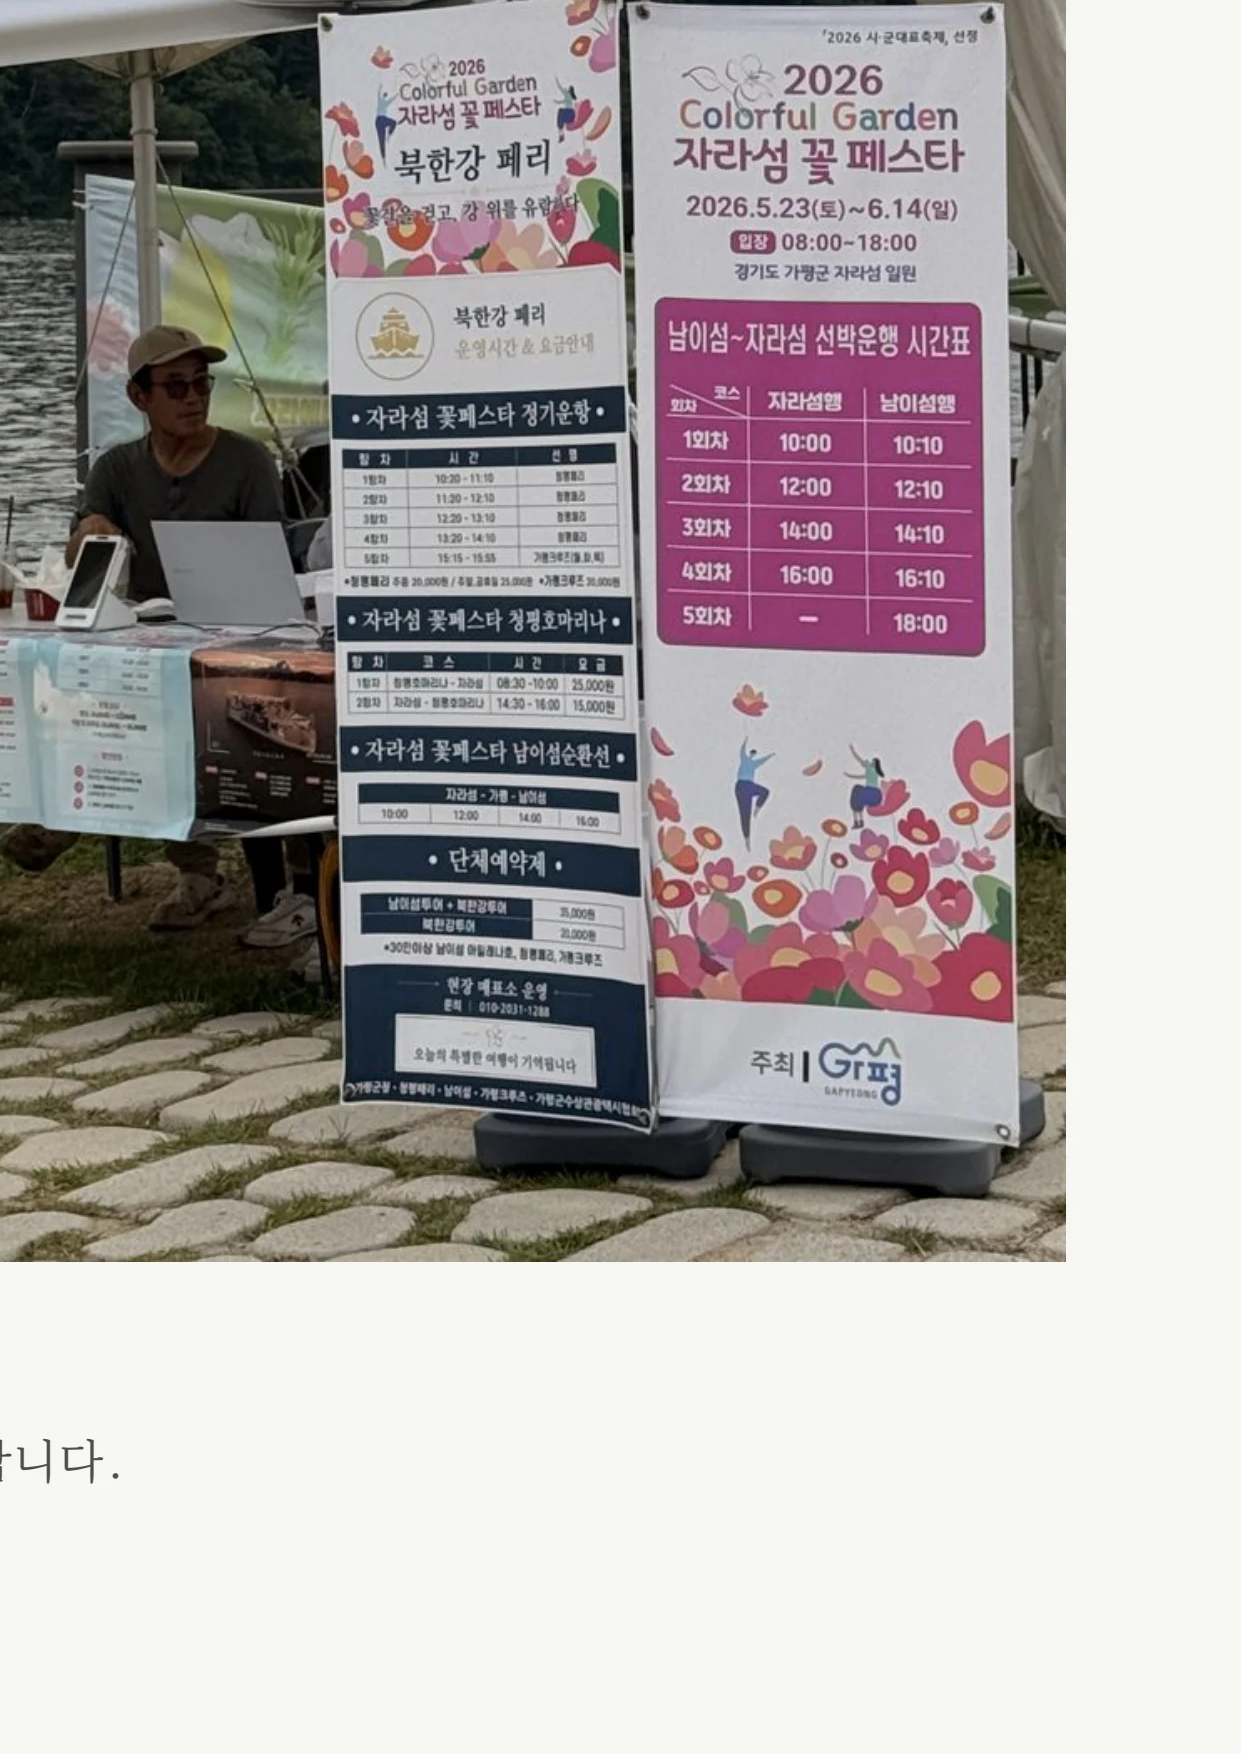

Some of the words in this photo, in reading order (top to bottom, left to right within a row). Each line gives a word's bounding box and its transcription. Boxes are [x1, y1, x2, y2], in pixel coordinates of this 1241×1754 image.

[953, 29, 978, 44] 선정
[449, 59, 486, 77] 2026
[783, 63, 884, 96] 2026
[399, 79, 468, 101] Colorful
[476, 75, 537, 97] Garden
[398, 103, 455, 131] 자라섬
[461, 101, 480, 129] 꽃
[484, 95, 542, 121] 페스타
[679, 99, 817, 131] Colorful
[833, 101, 959, 132] Garden
[394, 144, 486, 185] 북한강
[496, 138, 552, 179] 페리
[673, 137, 789, 184] 자라섬
[801, 138, 838, 186] 꽃
[846, 138, 966, 173] 페스타
[463, 201, 480, 222] 강
[486, 199, 517, 220] 위를
[686, 194, 958, 222] 2026.5.23(토)~6.14(일)
[738, 233, 768, 251] 입장
[781, 233, 917, 252] 08:00~18:00
[734, 264, 780, 282] 경기도
[784, 264, 830, 282] 가평군
[834, 264, 882, 282] 자라섬
[886, 264, 917, 282] 일원
[453, 304, 509, 328] 북한강
[513, 302, 546, 327] 페리
[454, 336, 519, 361] 운영시간
[539, 332, 594, 355] 요금안내
[668, 319, 806, 356] 남이섬~자라섬
[816, 324, 899, 358] 선박운행
[907, 325, 971, 358] 시간표
[670, 398, 697, 413] 회차
[768, 391, 842, 413] 자라섬행
[880, 393, 956, 414] 남이섬행
[713, 385, 741, 400] 코스
[365, 405, 429, 431] 자라섬
[435, 400, 516, 430] 꽃페스타
[521, 398, 591, 426] 정기운항
[683, 429, 729, 451] 1회차
[780, 433, 832, 453] 10:00
[893, 435, 943, 456] 10:10
[436, 473, 461, 484] 10:20
[470, 473, 494, 484] 11:10
[681, 473, 731, 494] 2회차
[780, 477, 832, 497] 12:00
[895, 479, 944, 499] 12:10
[436, 493, 461, 504] 11:20
[470, 493, 495, 504] 12:10
[437, 513, 462, 524] 12:20
[681, 517, 731, 538] 3회차
[780, 521, 833, 541] 14:00
[895, 524, 944, 544] 14:10
[681, 561, 732, 582] 4회차
[780, 565, 834, 585] 16:00
[895, 569, 945, 589] 16:10
[362, 609, 420, 634] 자라섬
[427, 609, 502, 634] 꽃페스타
[508, 609, 608, 635] 청평호마리나
[682, 606, 732, 627] 5회차
[893, 613, 948, 634] 18:00
[364, 739, 424, 763] 자라섬
[431, 741, 507, 765] 꽃페스타
[513, 742, 612, 769] 남이섬순환선
[381, 808, 409, 820] 10:00
[453, 810, 480, 822] 12:00
[518, 812, 543, 824] 14:00
[576, 816, 600, 828] 16:00
[449, 848, 547, 877] 단체예약제
[446, 976, 474, 995] 현장
[750, 1050, 794, 1077] 주최
